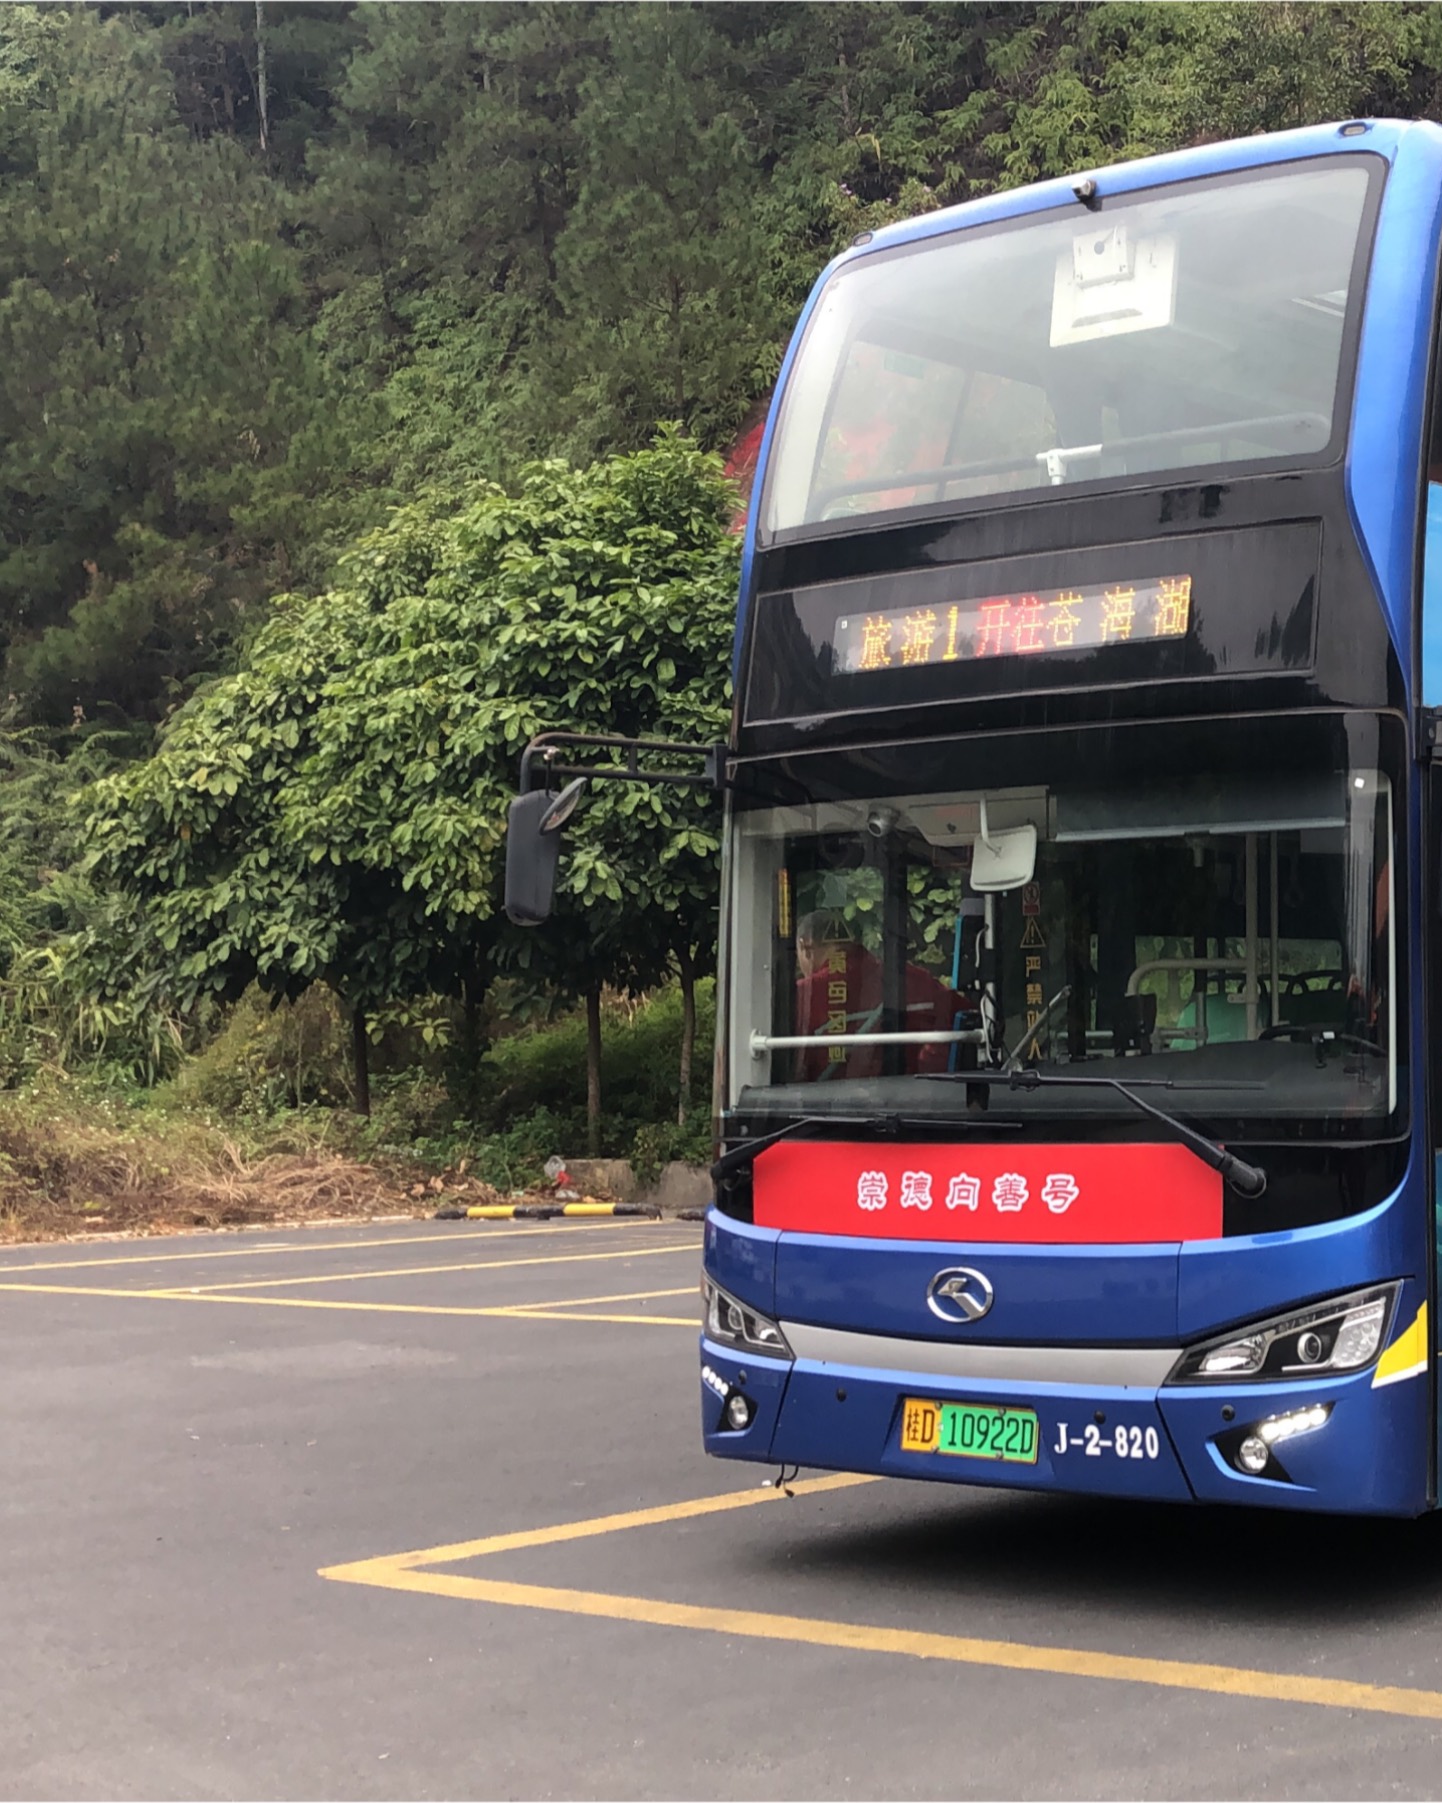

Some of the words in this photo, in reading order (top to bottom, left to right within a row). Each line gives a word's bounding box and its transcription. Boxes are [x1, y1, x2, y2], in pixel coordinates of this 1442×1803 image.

[858, 1171, 1079, 1213] 崇德向善号
[1054, 1421, 1159, 1459] J-2-820
